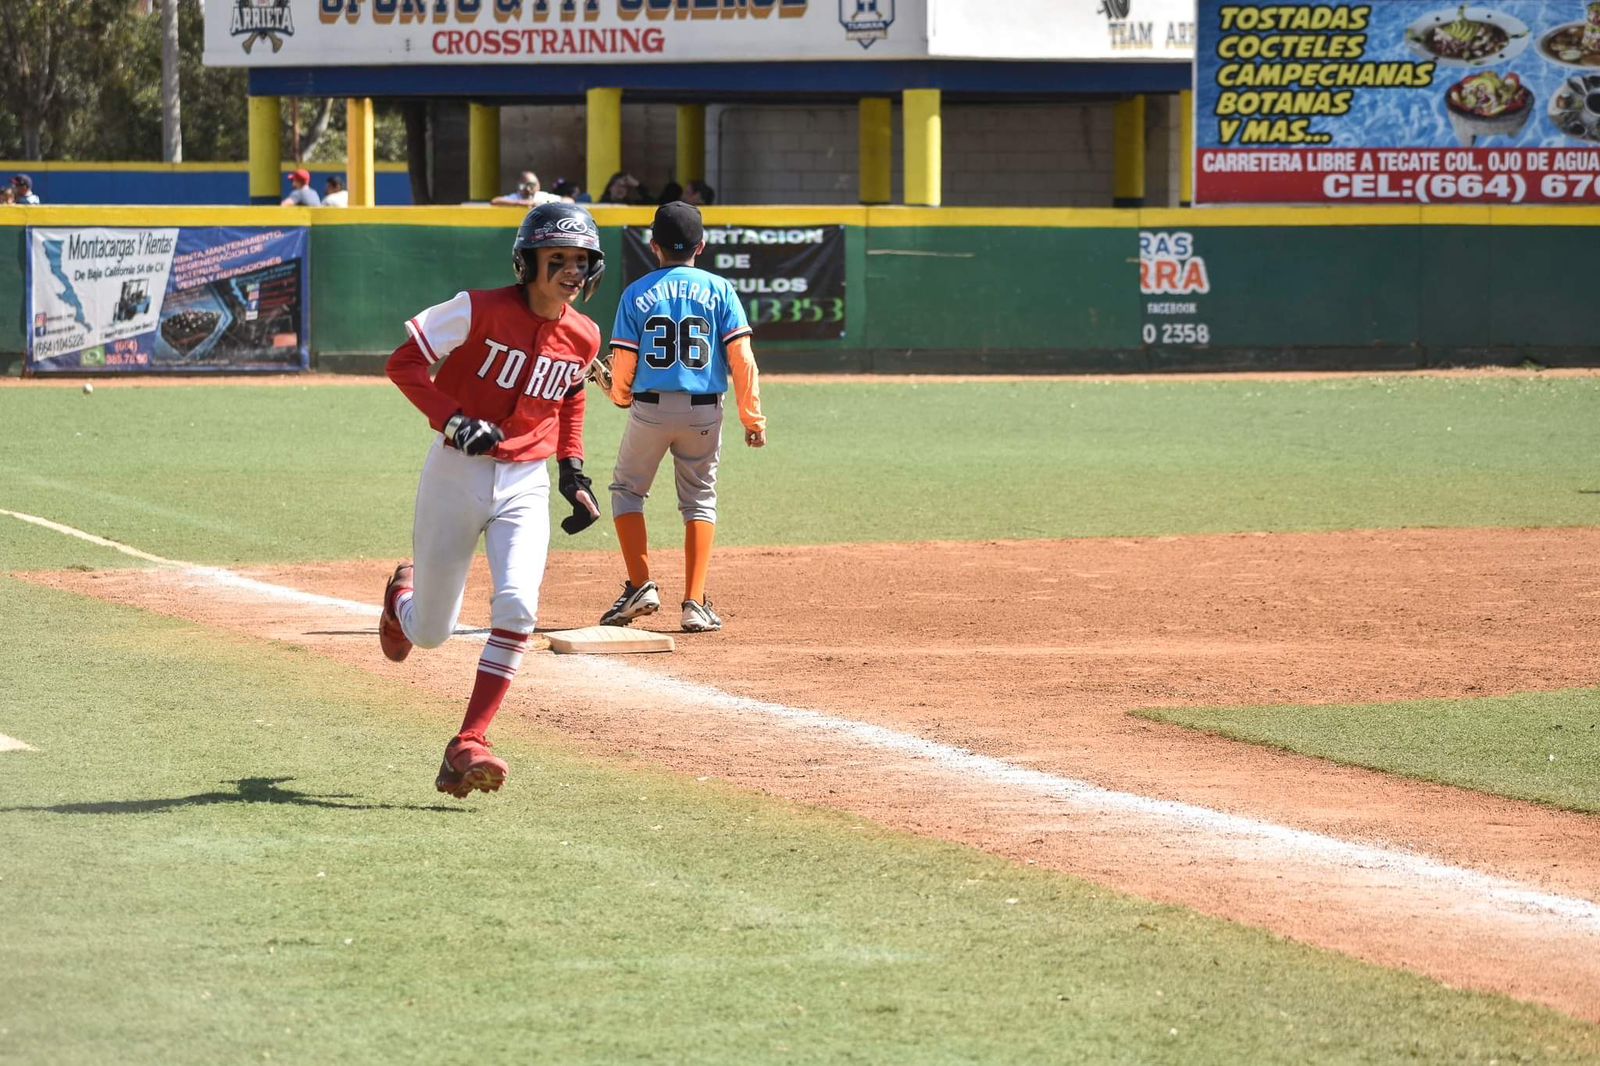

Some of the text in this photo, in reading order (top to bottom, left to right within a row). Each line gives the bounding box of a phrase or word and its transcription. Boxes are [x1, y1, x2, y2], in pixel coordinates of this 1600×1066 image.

[230, 6, 295, 36] ARRIETA
[1219, 6, 1371, 31] TOSTADAS
[432, 28, 665, 54] CROSSTRAINING
[1108, 22, 1153, 48] TEAM
[1217, 34, 1367, 60] COCTELES
[1216, 62, 1436, 88] CAMPECHANAS
[1214, 91, 1353, 116] BOTANAS
[1219, 119, 1241, 144] Y
[1202, 152, 1600, 173] CARRETERA LIBRE A TECATE COL. OJO DE AGUA
[1540, 174, 1600, 198] 67
[69, 232, 173, 263] Montacargas Y Rentas
[716, 254, 751, 269] DE
[635, 279, 721, 314] ONTIVEROS
[1147, 302, 1198, 315] FACEBOOK
[644, 313, 711, 371] 36
[1161, 323, 1210, 344] 2358
